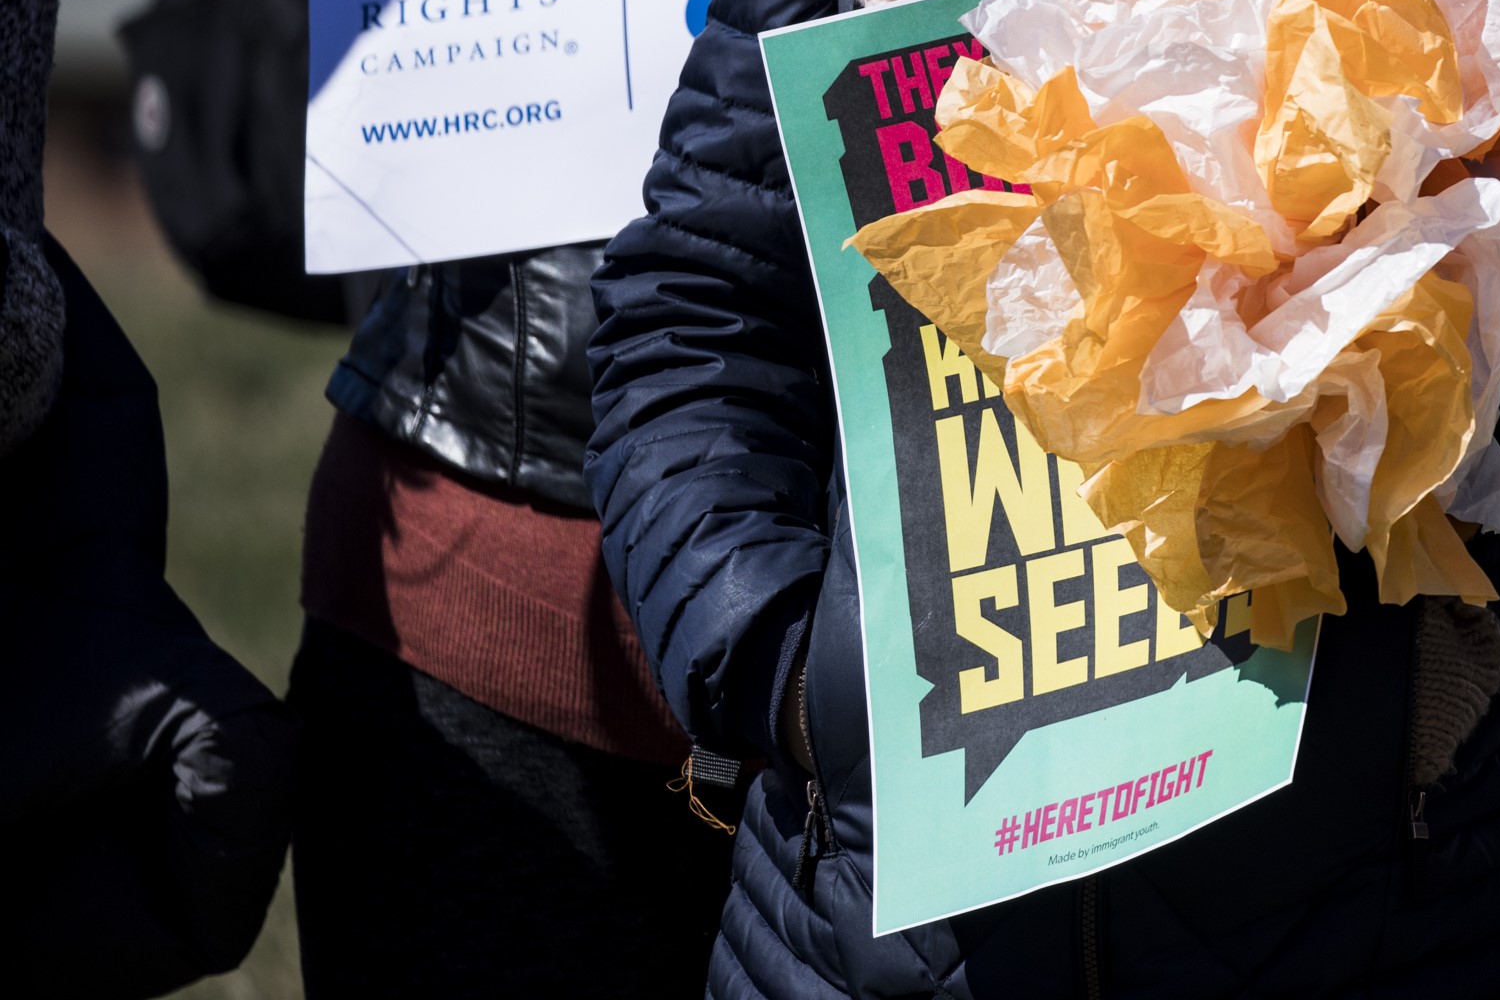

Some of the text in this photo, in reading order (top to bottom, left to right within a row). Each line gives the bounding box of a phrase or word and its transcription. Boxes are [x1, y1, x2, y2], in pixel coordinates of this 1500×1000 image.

[361, 100, 562, 144] WWW.HRC.ORG
[994, 748, 1214, 857] #HERETOFIGHT
[1048, 821, 1160, 866] Made by immigrant youth.
